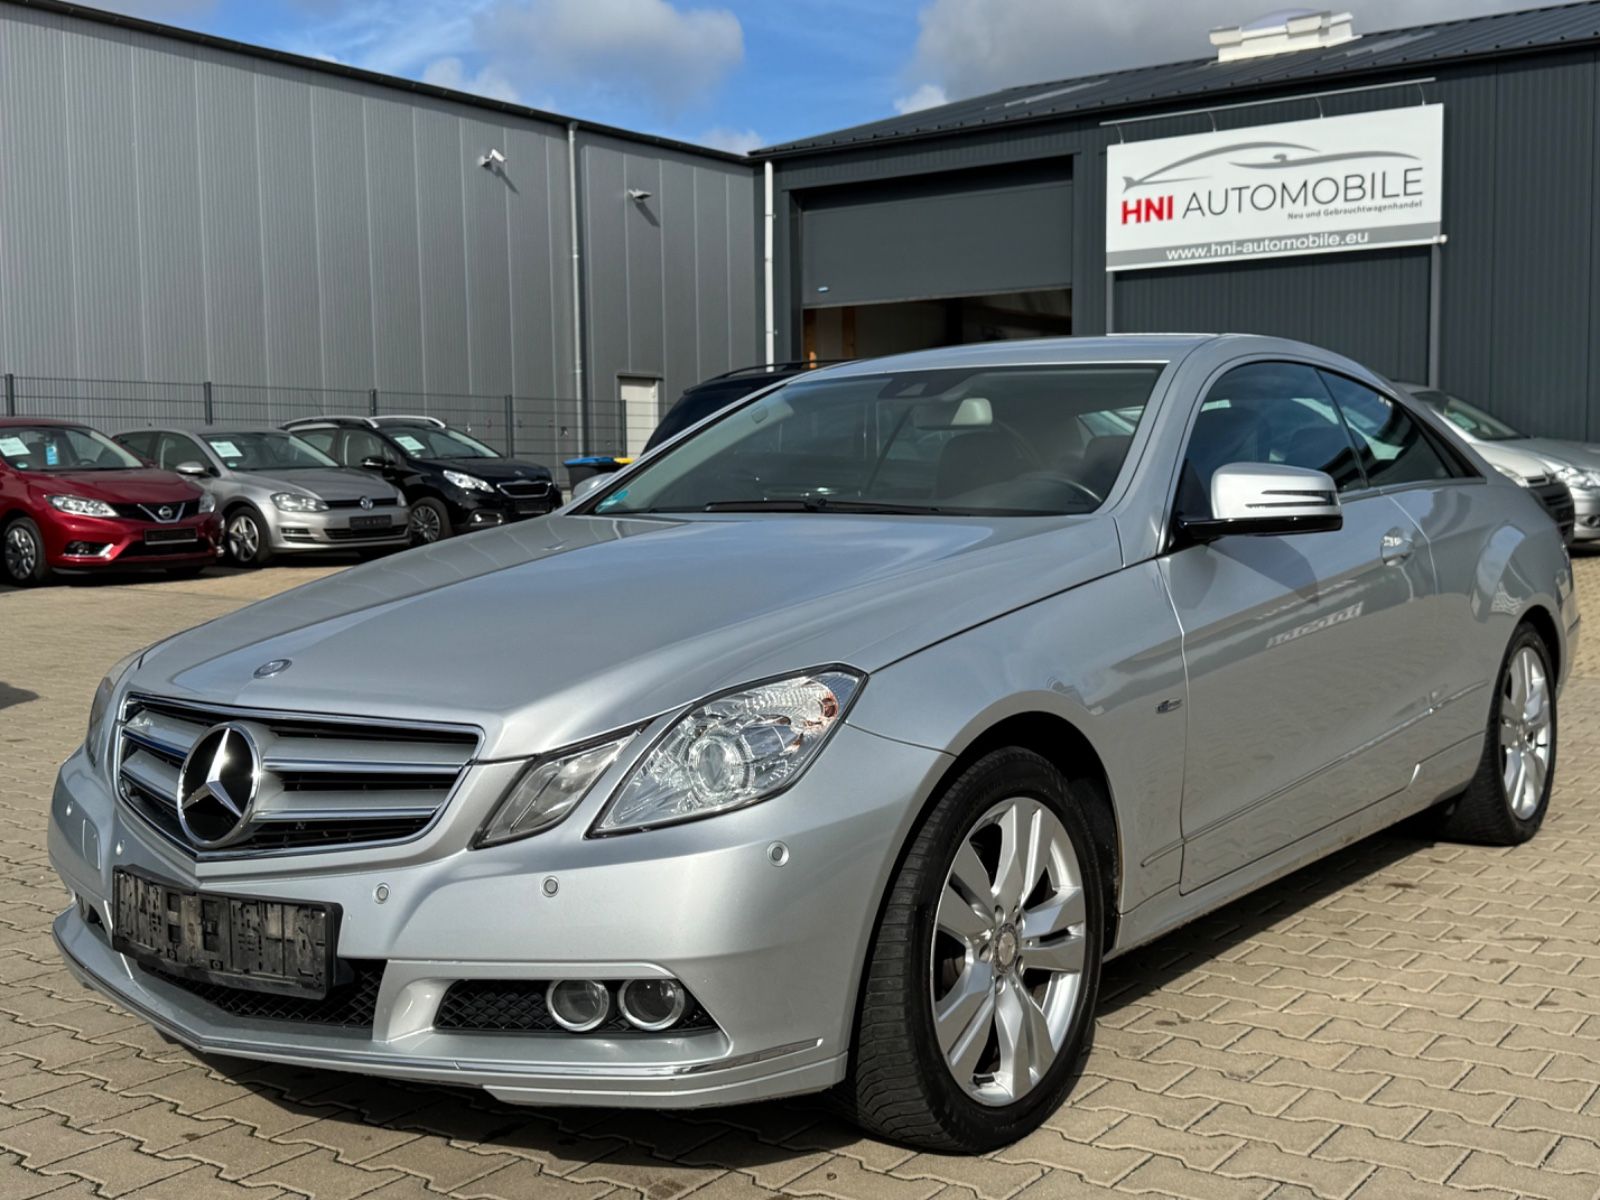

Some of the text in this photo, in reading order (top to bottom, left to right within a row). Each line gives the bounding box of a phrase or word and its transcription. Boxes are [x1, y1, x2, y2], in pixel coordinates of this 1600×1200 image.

[1121, 167, 1424, 225] HNI AUTOMOBILE
[1287, 200, 1423, 220] Neu und Gebrauchtwagenhandel
[1165, 231, 1370, 260] www.hni-automobile.eu
